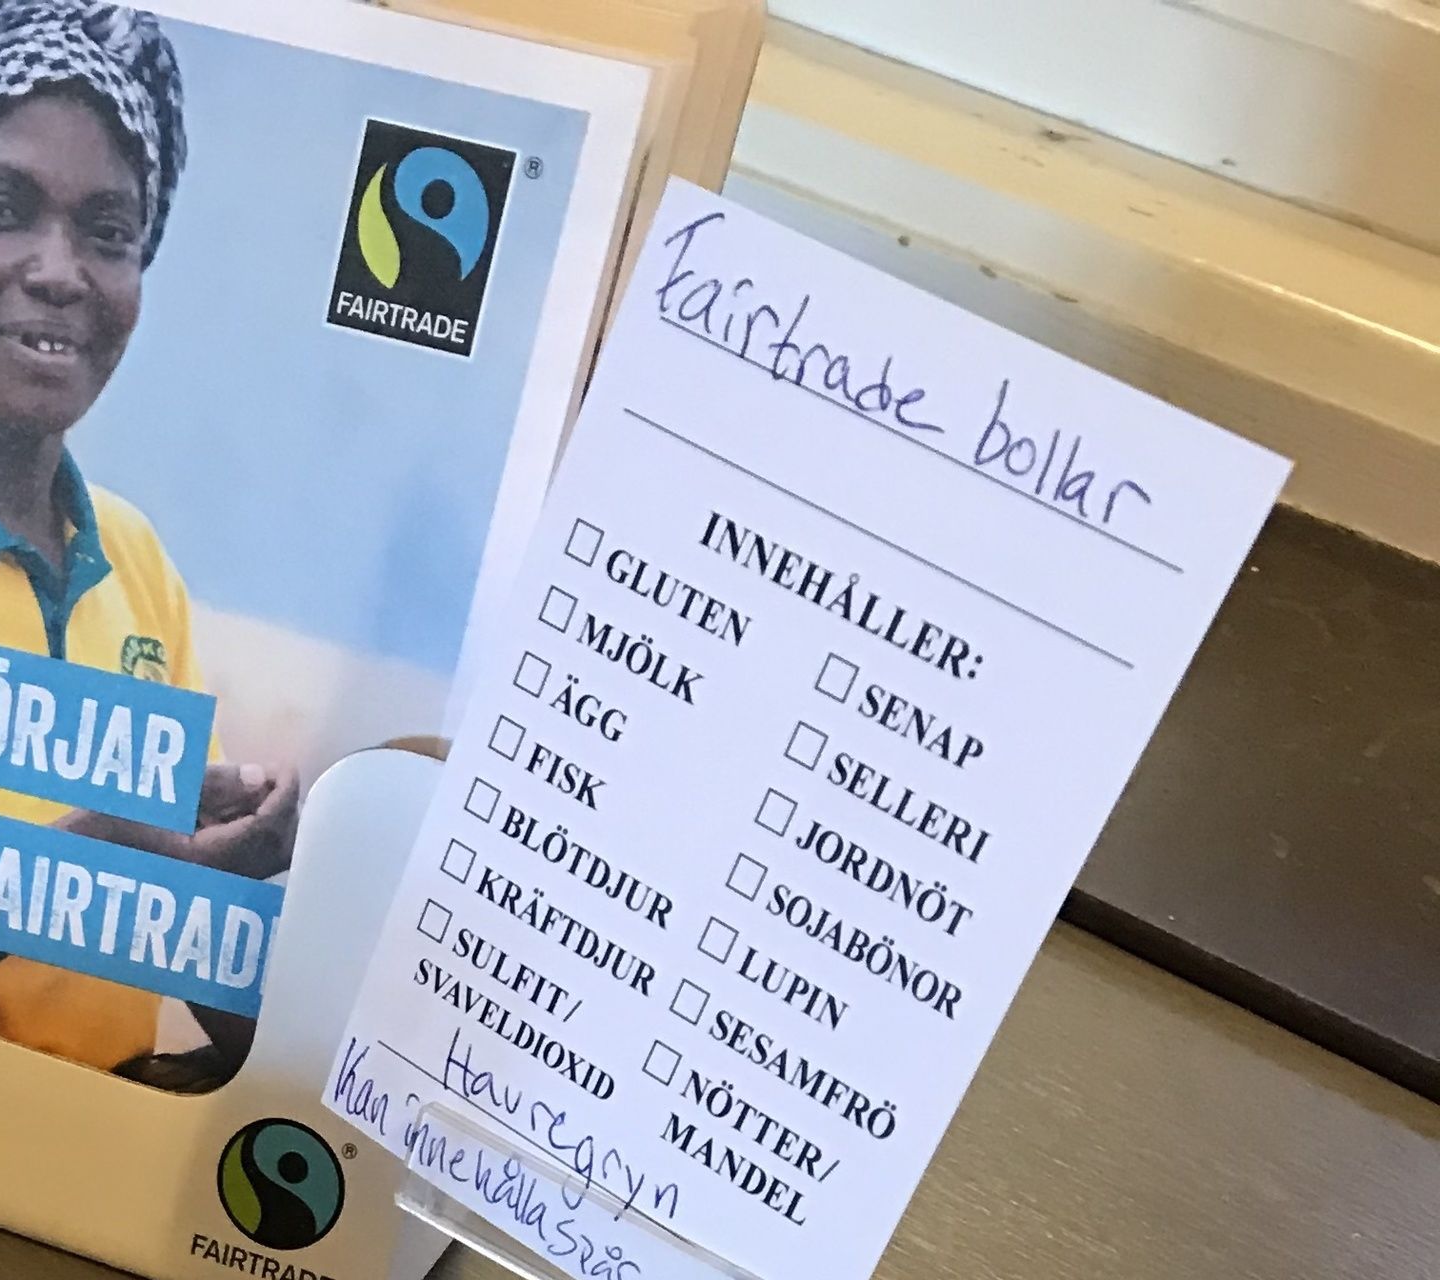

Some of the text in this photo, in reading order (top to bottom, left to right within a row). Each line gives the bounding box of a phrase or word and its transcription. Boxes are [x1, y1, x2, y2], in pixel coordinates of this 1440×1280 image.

[336, 291, 469, 344] FAIRTRADE
[655, 214, 1152, 524] Fairtrade bollar
[606, 548, 752, 646] GLUTEN
[699, 511, 983, 681] INNEHÅLLER:
[549, 674, 629, 744] ÄGG
[577, 612, 705, 704] MJÖLK
[526, 742, 607, 809] FISK
[859, 684, 985, 770] SENAP
[827, 752, 991, 862] SELLERI
[500, 803, 674, 929] BLÖTDJUR
[796, 822, 972, 936] JORDNÖT
[452, 929, 582, 1022] SULFIT/
[475, 866, 657, 996] KRÄFTDJUR
[765, 884, 964, 1020] SOJABÖNOR
[414, 960, 615, 1100] SVAVELDIOXID
[737, 947, 849, 1030] LUPIN
[334, 1037, 388, 1136] Kan
[680, 1069, 841, 1184] NÖTTER/
[709, 1011, 897, 1139] SESAMFRÖ
[660, 1112, 807, 1226] MANDEL
